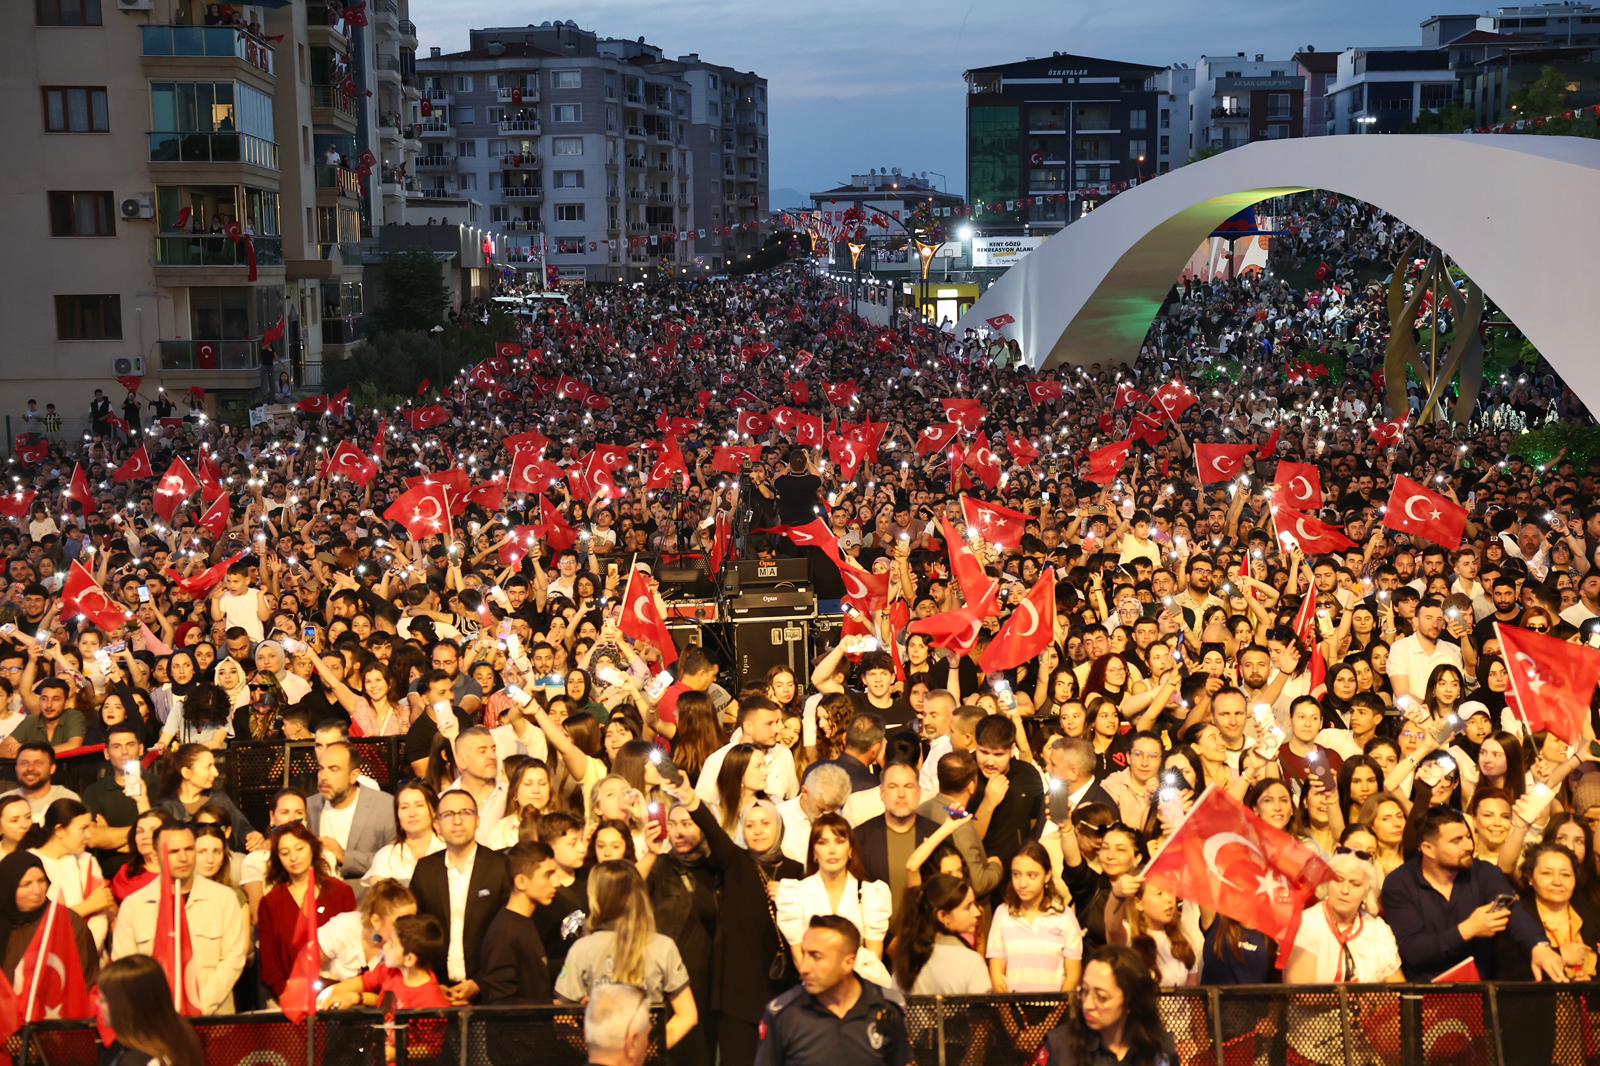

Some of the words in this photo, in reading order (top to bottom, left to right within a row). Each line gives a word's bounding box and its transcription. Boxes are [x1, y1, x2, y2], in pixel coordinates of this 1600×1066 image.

[1048, 68, 1088, 76] ÖZKAYALAR
[759, 560, 776, 568] Opus
[742, 654, 750, 674] Opus
